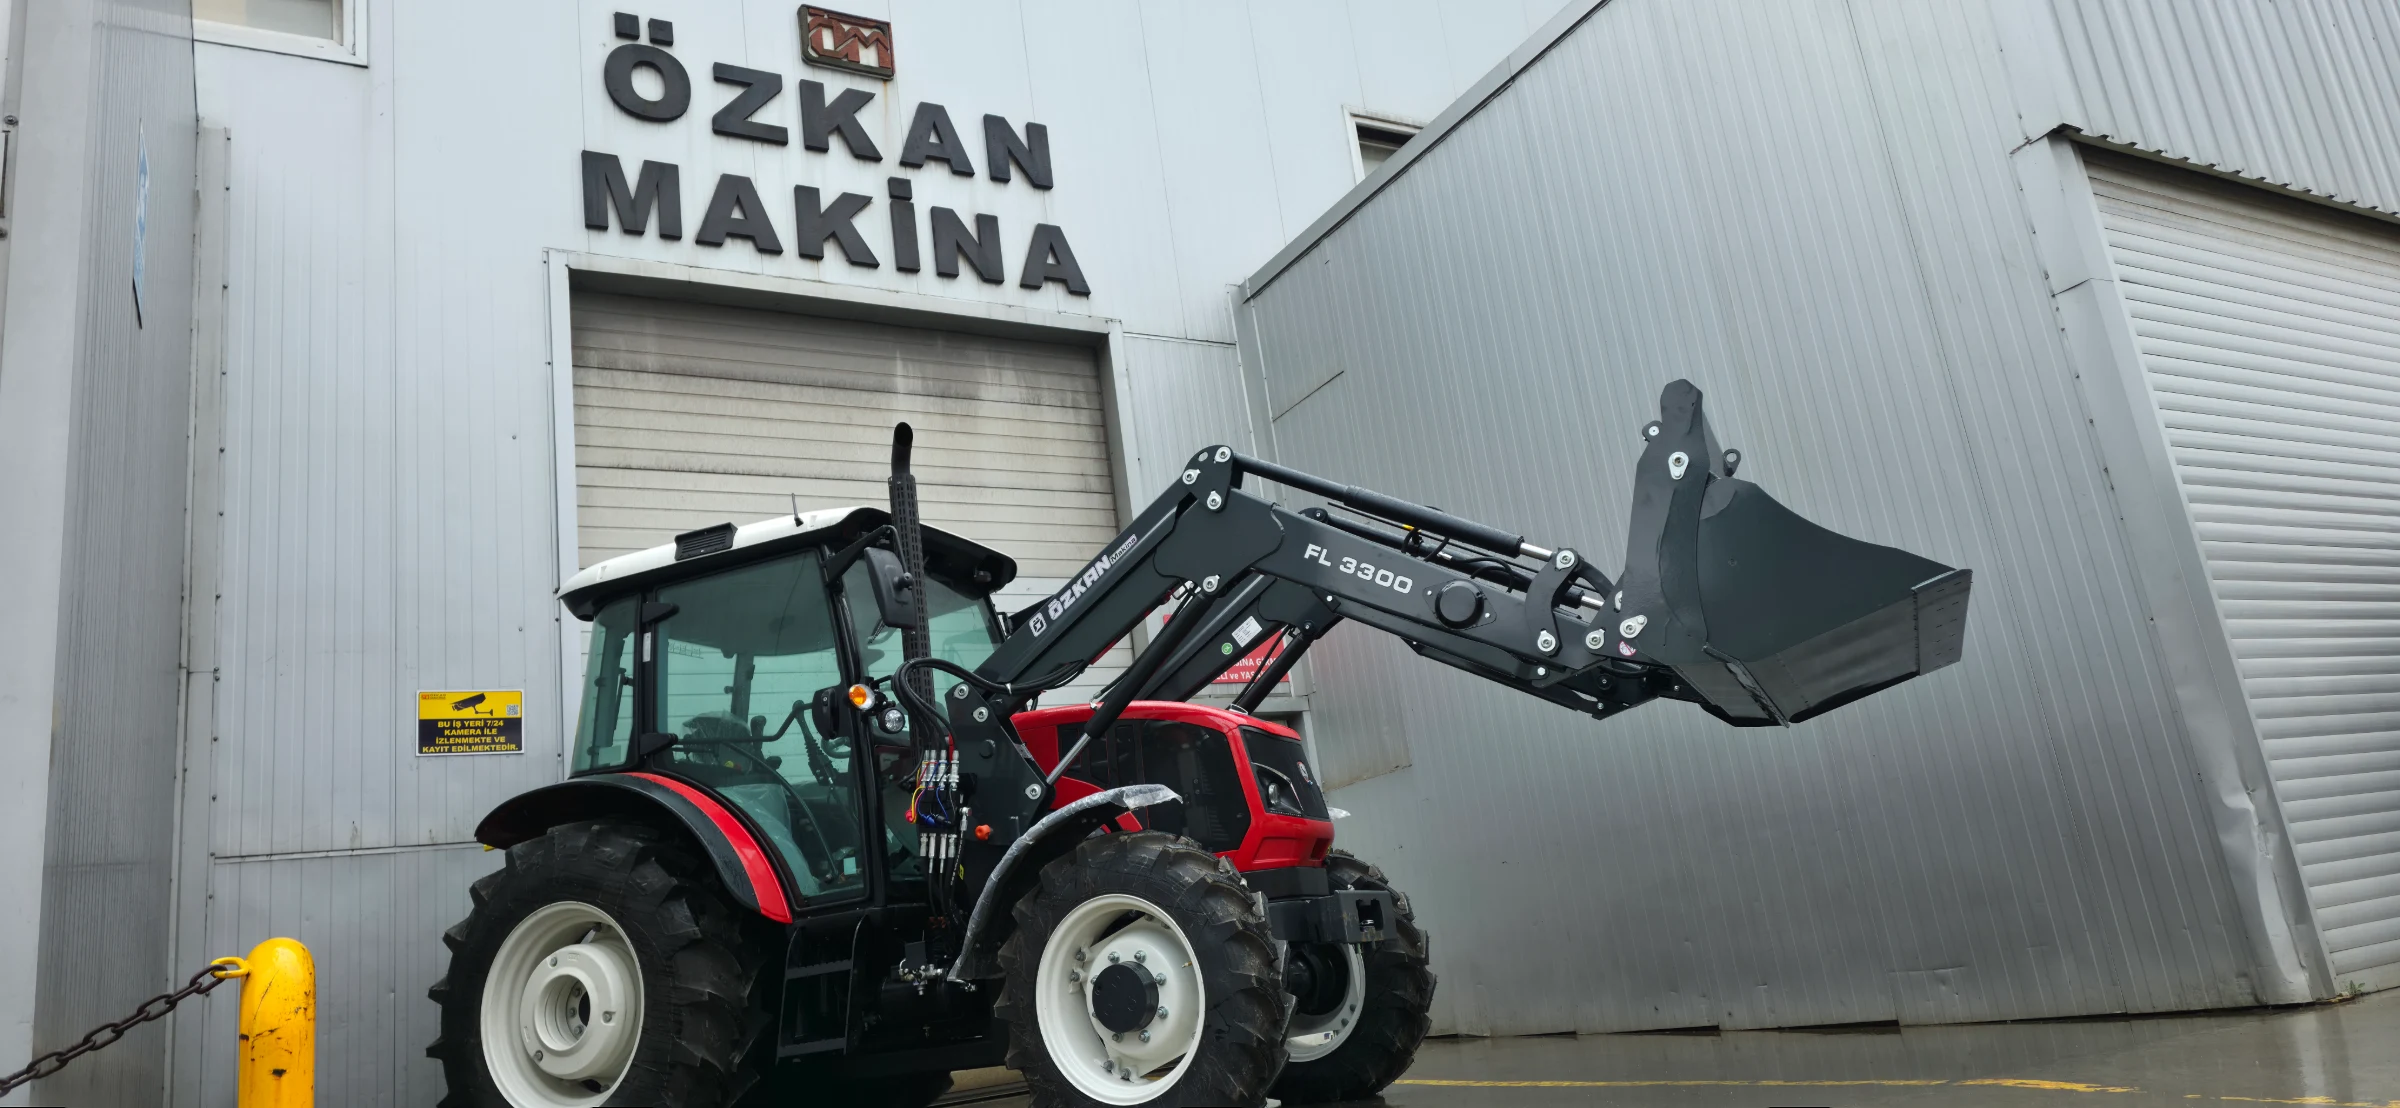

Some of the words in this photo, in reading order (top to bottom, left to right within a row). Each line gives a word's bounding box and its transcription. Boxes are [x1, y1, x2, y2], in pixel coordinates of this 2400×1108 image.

[604, 11, 1054, 190] ÖZKAN
[581, 149, 1091, 298] MAKİNA
[1048, 554, 1111, 621] ÖZKAN
[1109, 535, 1137, 564] Makina
[1304, 543, 1331, 567] FL
[1339, 556, 1413, 594] 3300
[444, 728, 481, 736] KAMERA
[484, 727, 498, 735] İLE
[464, 719, 484, 727] YERİ
